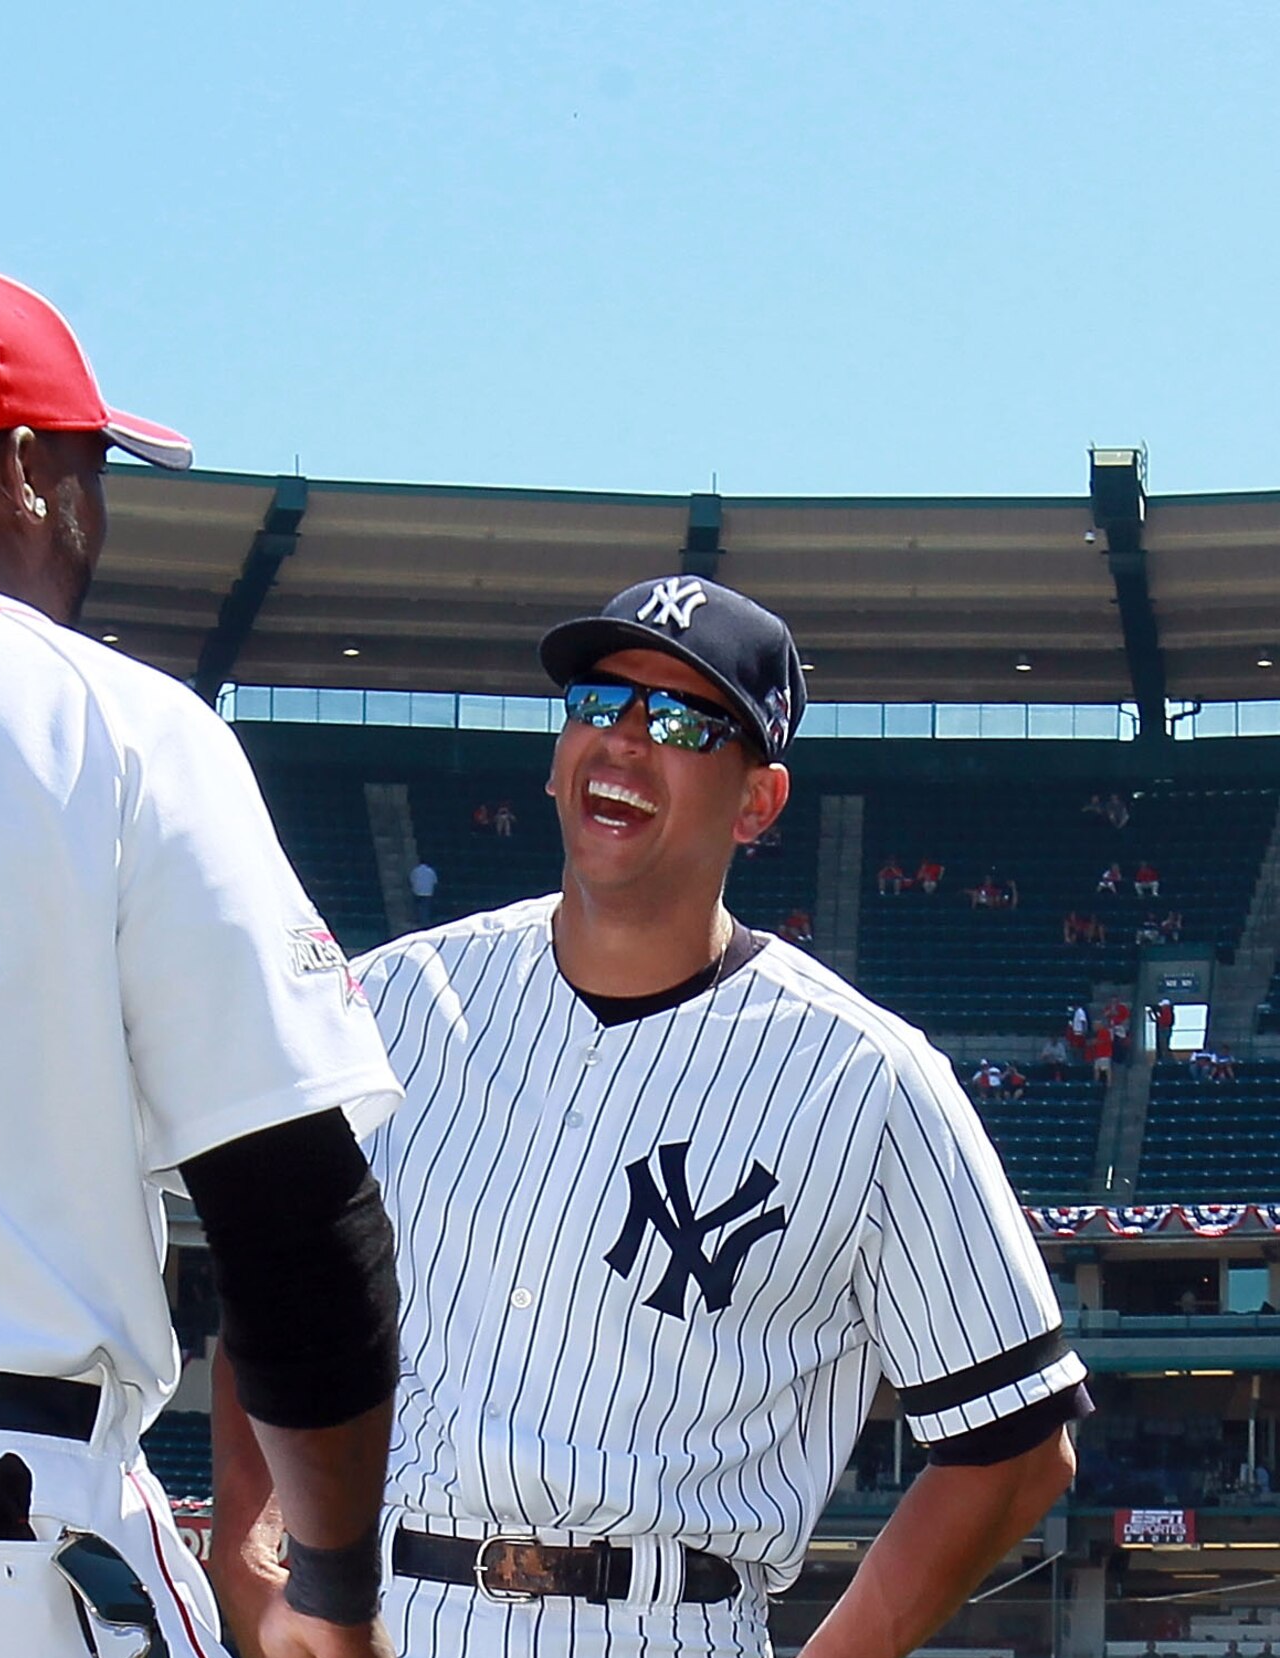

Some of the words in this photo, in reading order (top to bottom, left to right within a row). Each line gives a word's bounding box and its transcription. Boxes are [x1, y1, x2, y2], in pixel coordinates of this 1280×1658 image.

[637, 577, 707, 629] NY
[603, 1141, 787, 1321] NY
[1124, 1524, 1186, 1534] DEPORTES
[1131, 1510, 1183, 1524] ESPN
